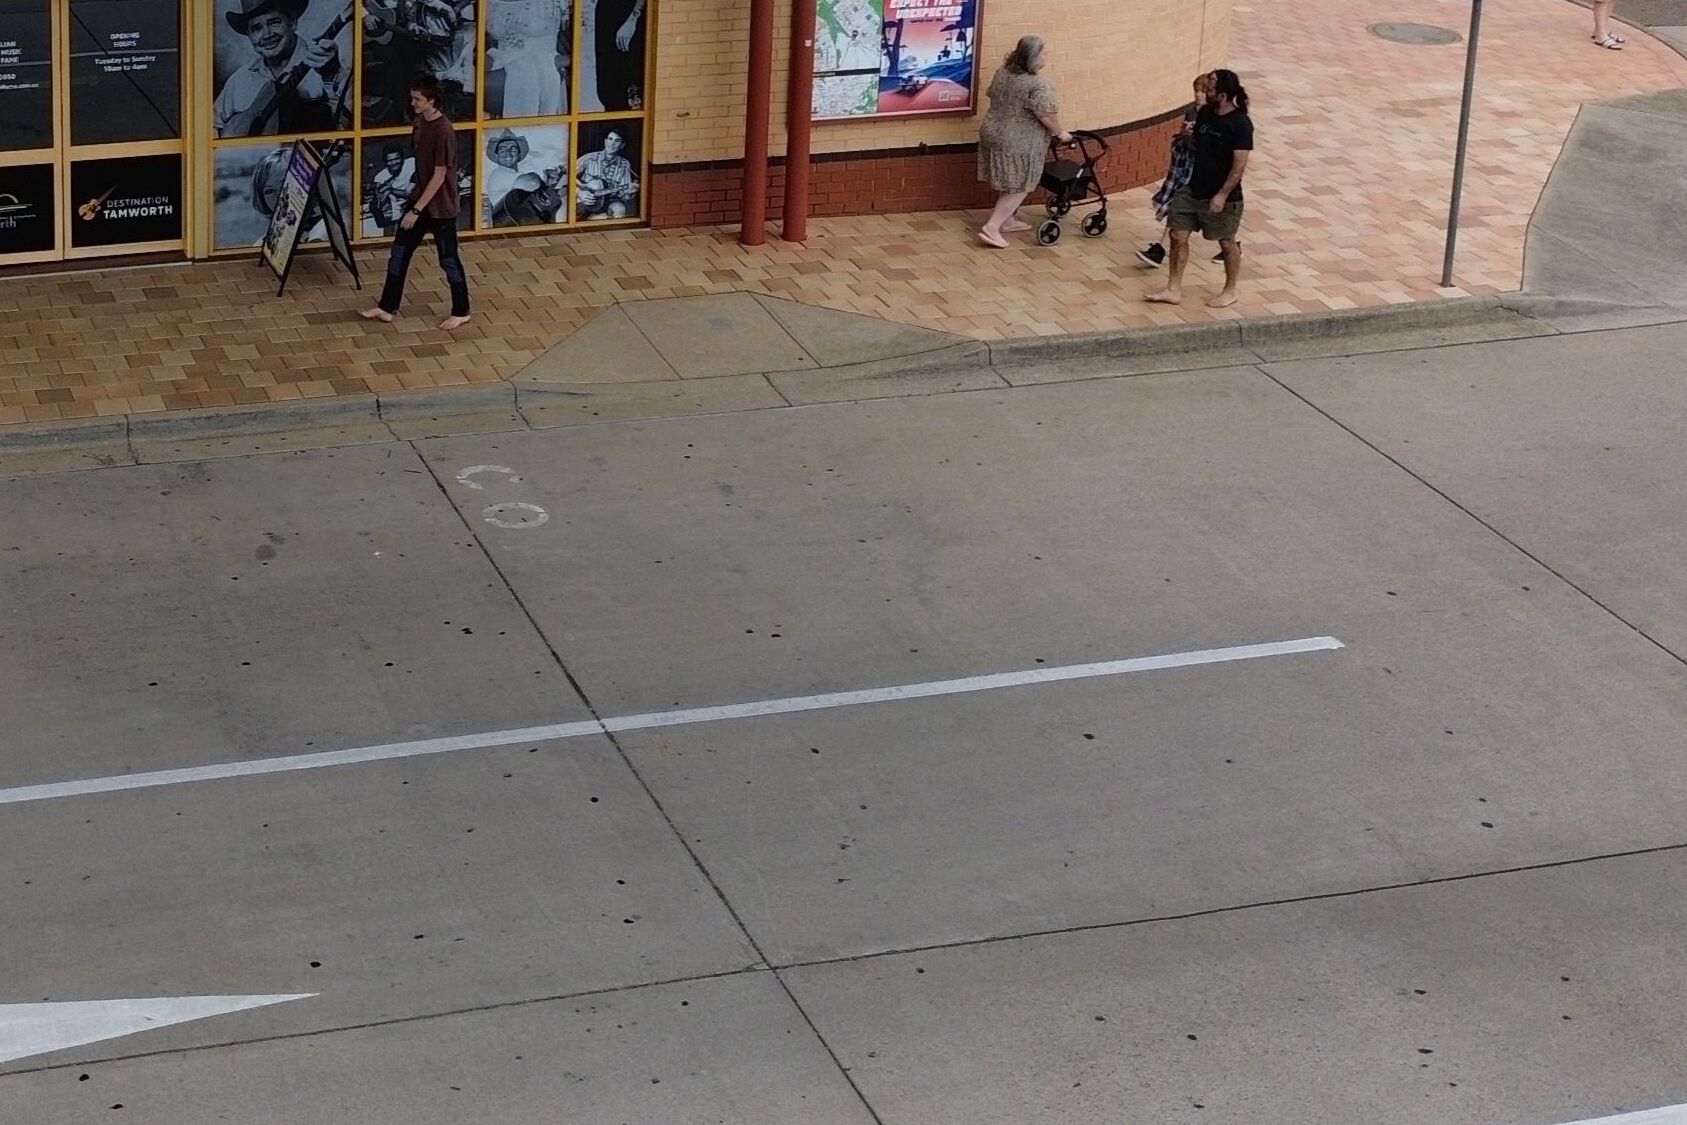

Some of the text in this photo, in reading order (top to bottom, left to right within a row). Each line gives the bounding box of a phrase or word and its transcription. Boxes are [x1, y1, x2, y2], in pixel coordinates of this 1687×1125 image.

[896, 6, 963, 20] UNEXPECTED
[107, 196, 169, 208] DESTINATION
[103, 205, 173, 220] TAMWORTH
